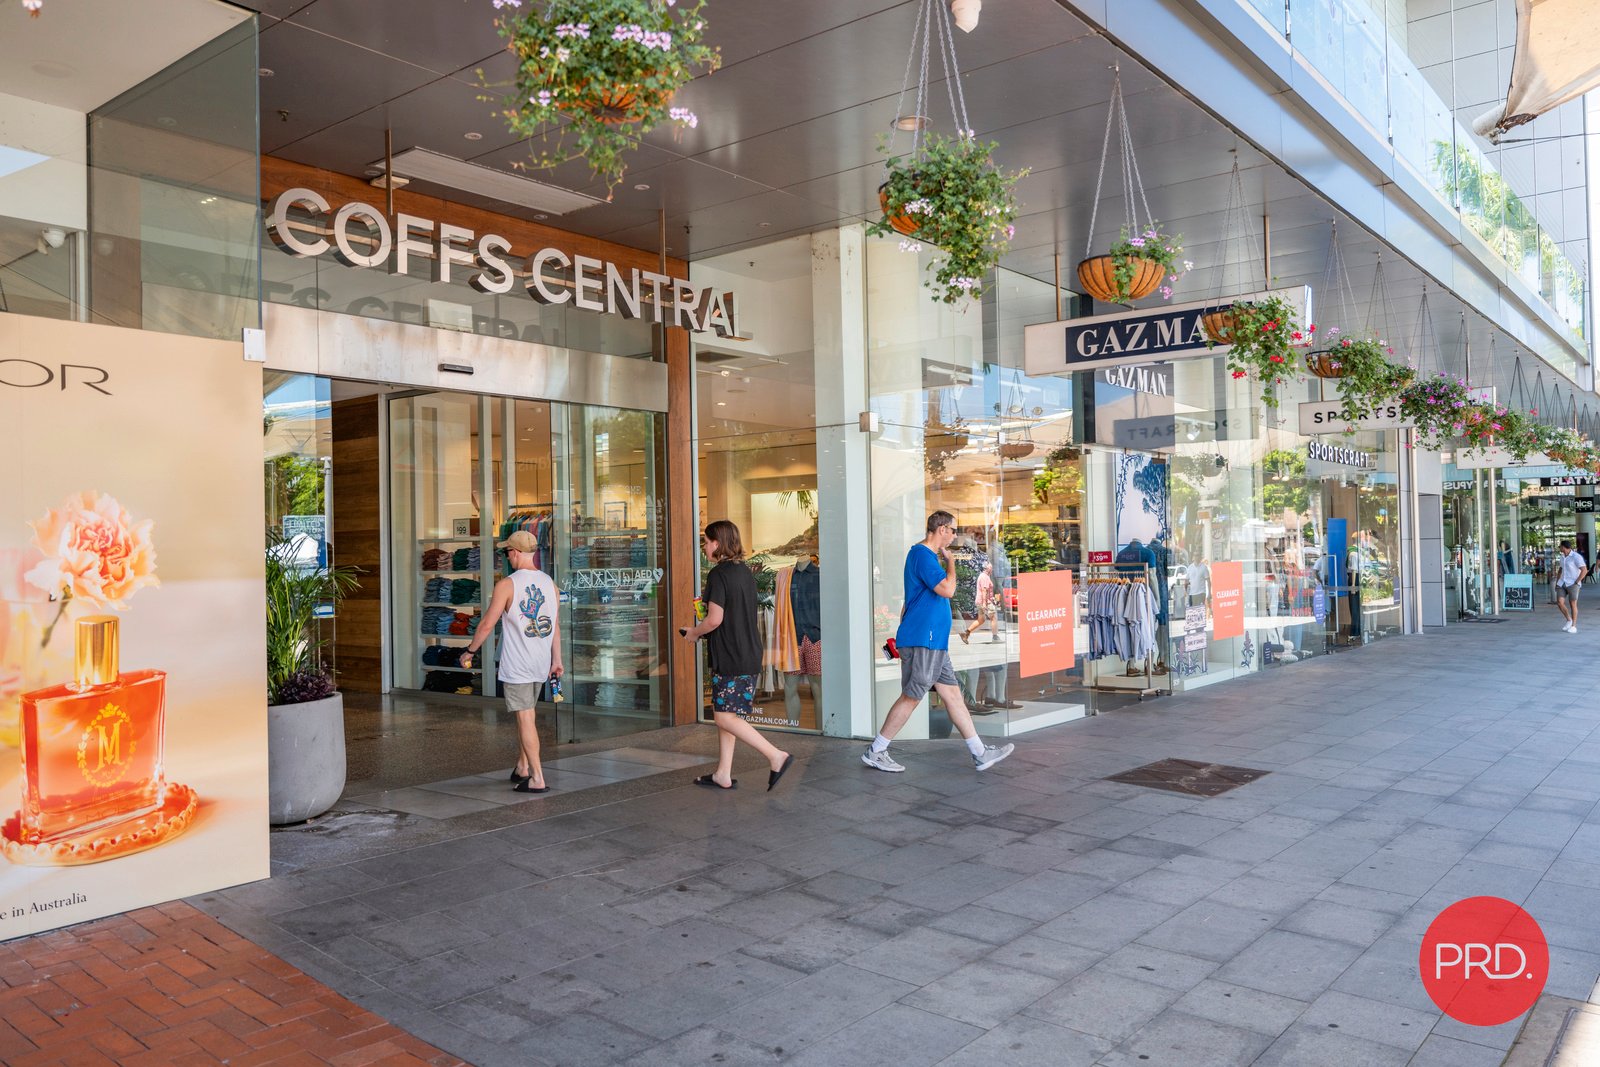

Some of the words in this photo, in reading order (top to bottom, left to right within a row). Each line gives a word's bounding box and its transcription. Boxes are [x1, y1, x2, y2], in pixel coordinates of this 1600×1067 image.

[265, 188, 515, 294] COFFS
[523, 247, 753, 341] CENTRAL
[1076, 314, 1210, 358] GAZMA
[1104, 366, 1167, 398] GAZMAN
[1308, 441, 1369, 469] SPORTSCRAFT
[634, 569, 653, 579] AED
[1216, 589, 1240, 599] CLEARANCE
[1026, 607, 1066, 621] CLEARANCE
[12, 906, 25, 918] in
[29, 892, 88, 915] Australia
